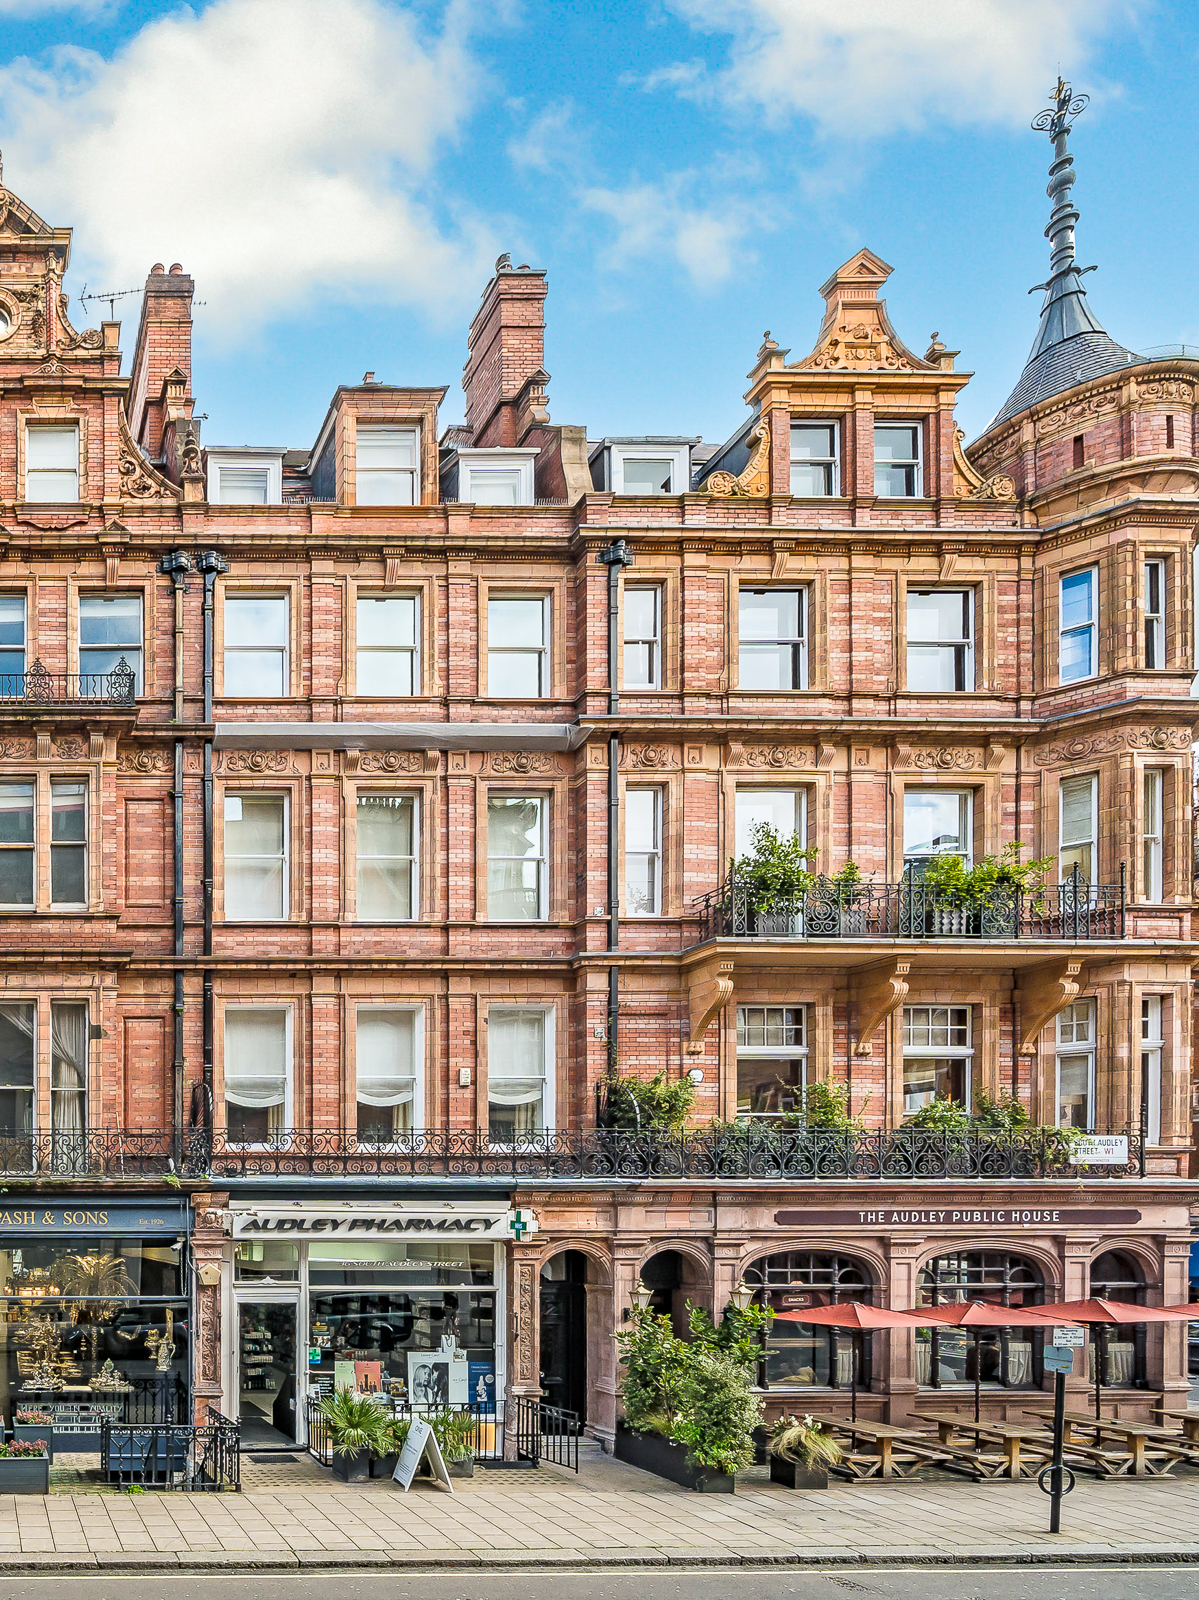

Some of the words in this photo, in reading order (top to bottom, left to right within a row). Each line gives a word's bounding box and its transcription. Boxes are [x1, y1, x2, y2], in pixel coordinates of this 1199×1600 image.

[42, 1211, 56, 1225] &
[63, 1211, 108, 1225] SONS
[858, 1211, 885, 1223] THE
[891, 1211, 946, 1223] AUDLEY
[952, 1211, 1006, 1222] PUBLIC
[1011, 1211, 1060, 1222] HOUSE
[240, 1218, 348, 1232] AUDLEY
[349, 1218, 502, 1232] PHARMACY
